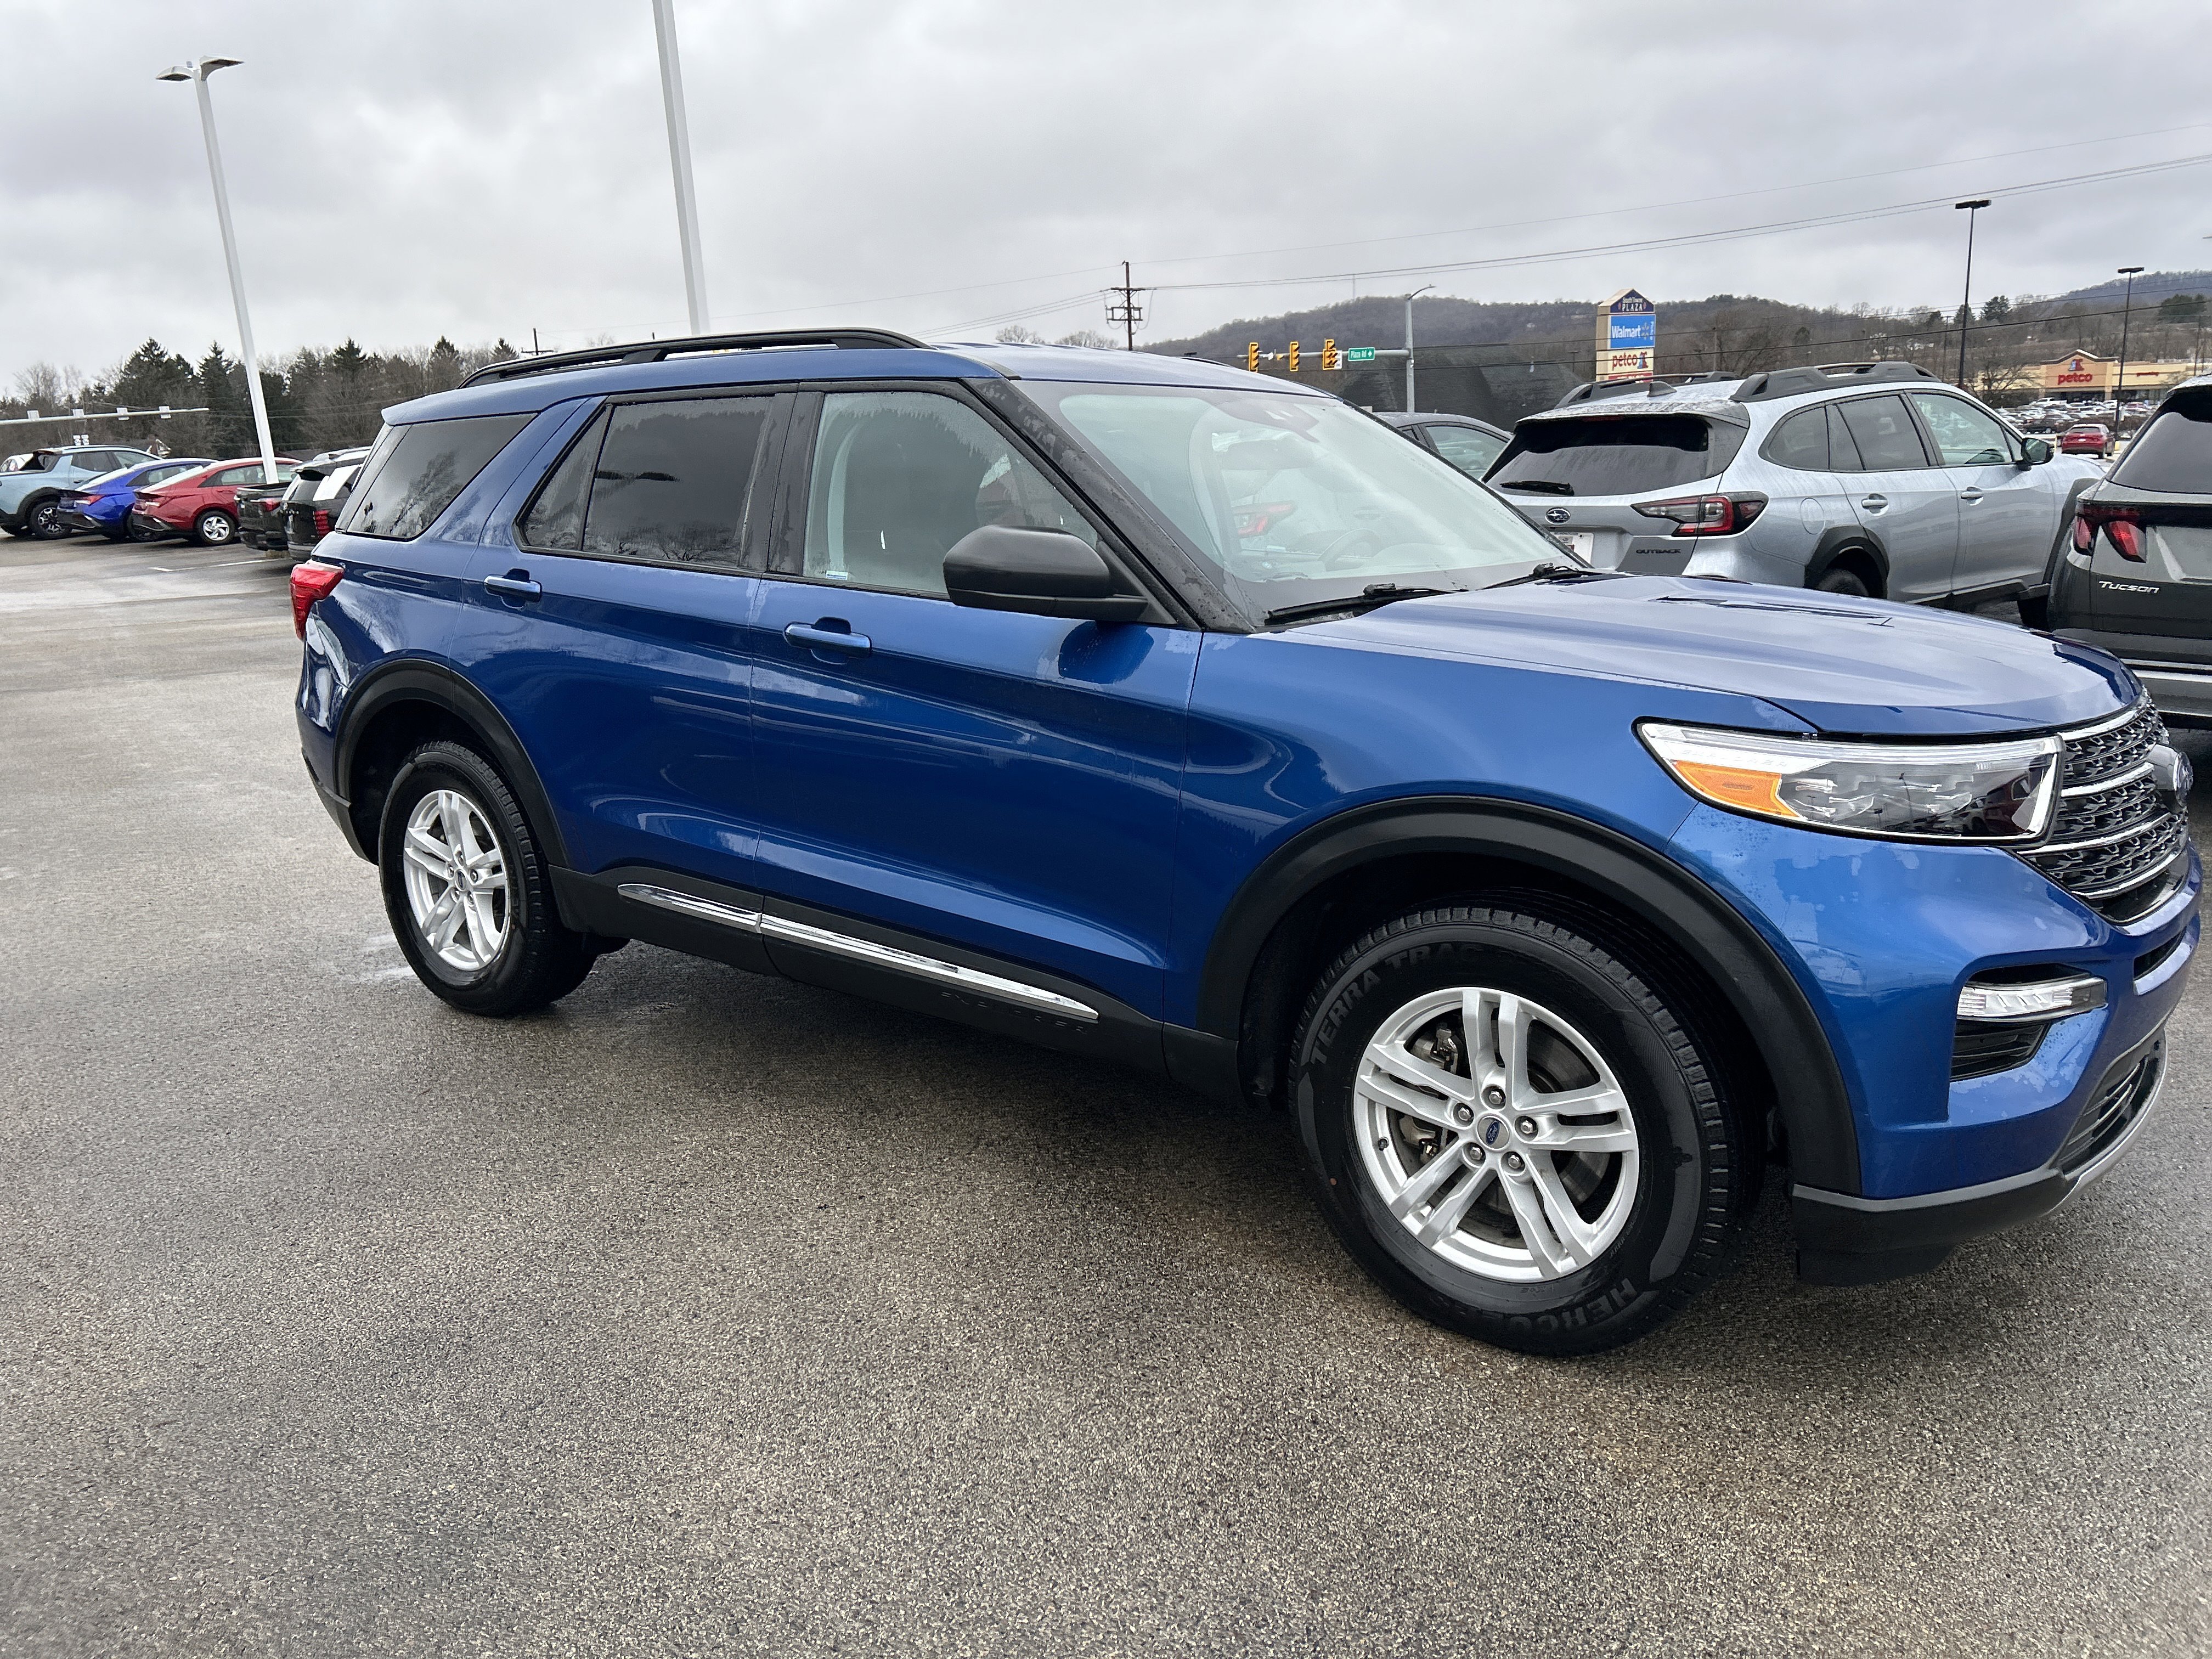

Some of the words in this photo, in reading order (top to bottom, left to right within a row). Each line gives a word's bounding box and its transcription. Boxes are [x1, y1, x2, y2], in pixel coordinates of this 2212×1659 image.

[1622, 303, 1643, 312] PLAZA
[1612, 325, 1641, 338] Walmart
[1612, 352, 1638, 371] petco
[2058, 373, 2092, 385] petco
[1310, 969, 1381, 1064] TERRA
[1487, 1123, 1498, 1142] Ford
